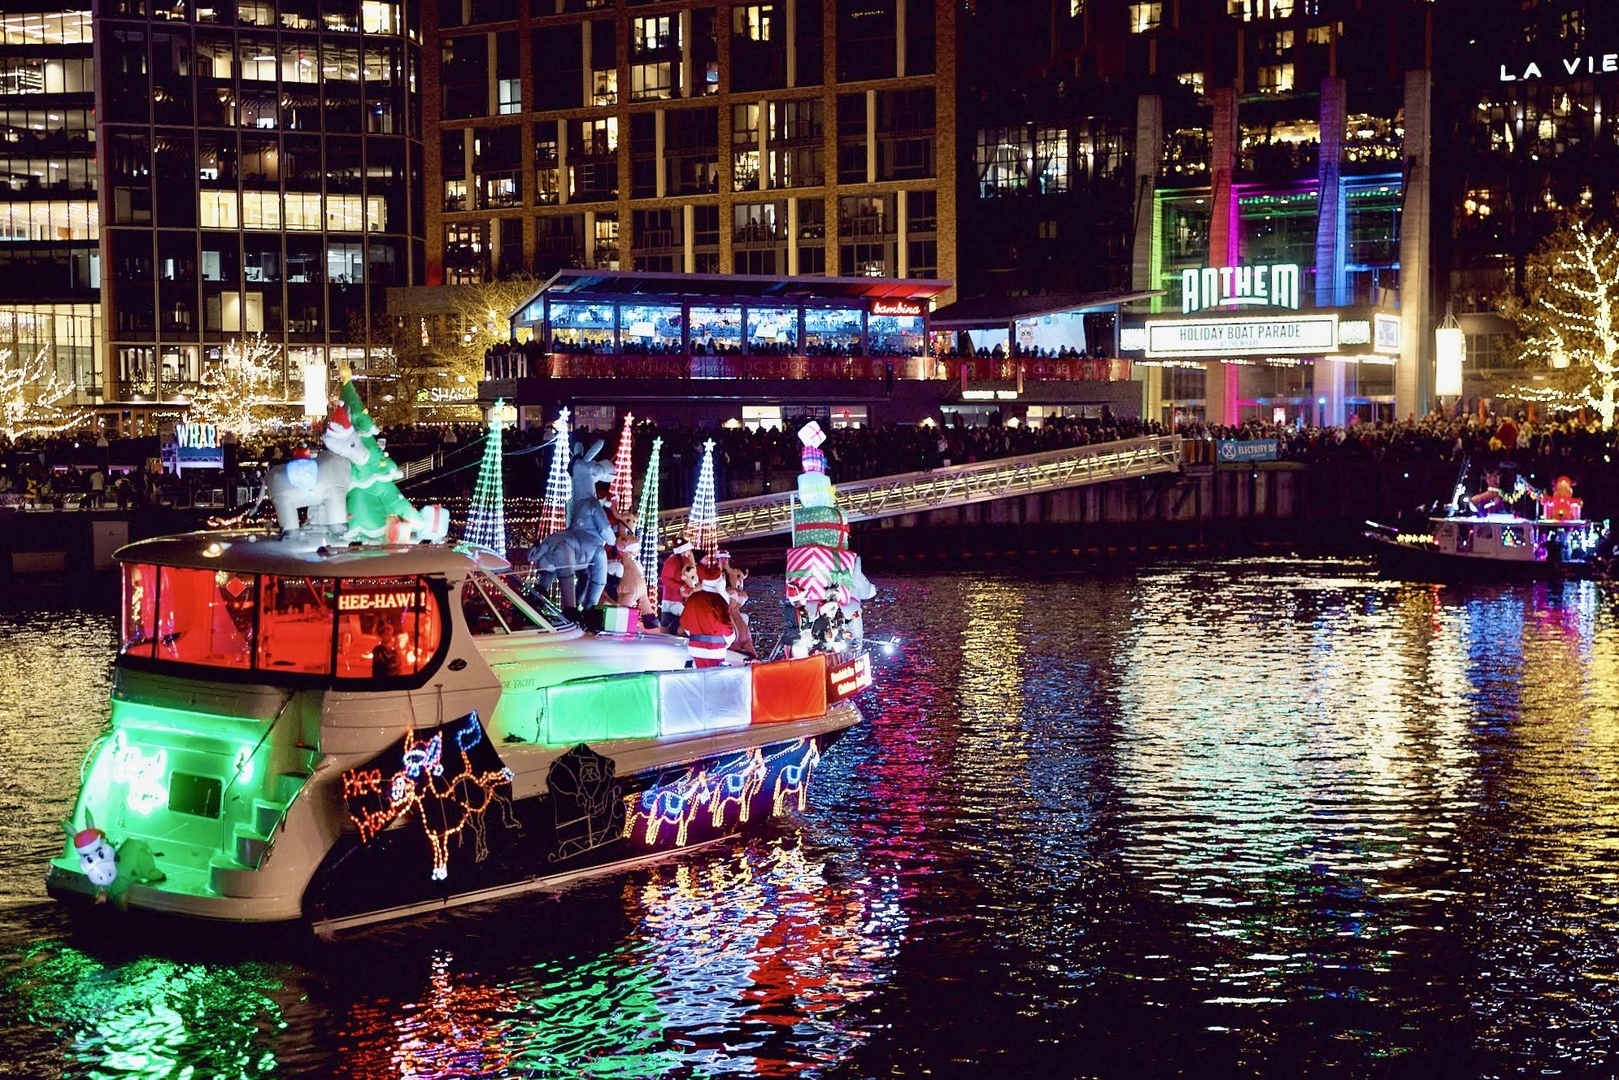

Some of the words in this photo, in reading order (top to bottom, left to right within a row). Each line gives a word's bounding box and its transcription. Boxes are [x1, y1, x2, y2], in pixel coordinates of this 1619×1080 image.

[1500, 62, 1542, 81] LA
[1562, 54, 1618, 75] VIE
[1182, 263, 1299, 315] ANTHEM
[873, 301, 921, 315] bambina
[1181, 327, 1224, 341] HOLIDAY
[1227, 325, 1254, 340] BOAT
[1258, 324, 1301, 339] PARADE
[780, 361, 818, 373] DOCK
[1033, 363, 1068, 374] GLOBE
[176, 423, 223, 449] WHARF
[513, 678, 536, 689] YACHT
